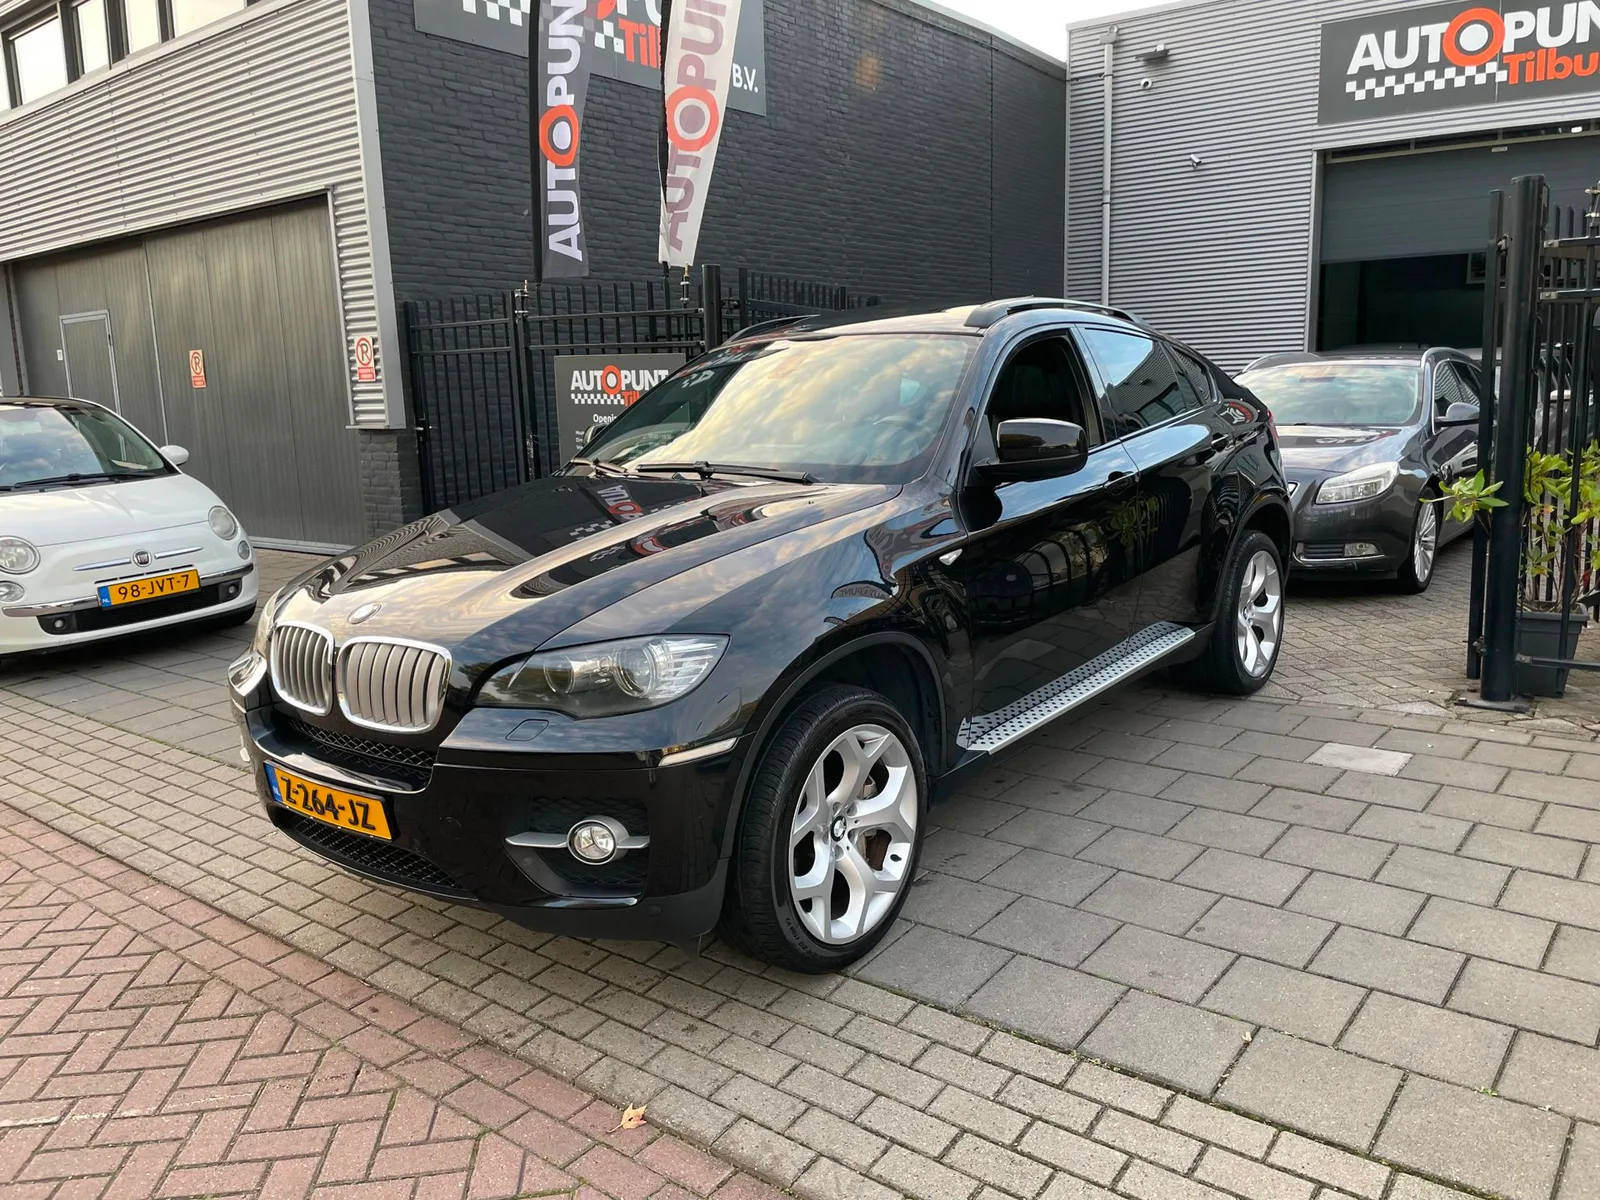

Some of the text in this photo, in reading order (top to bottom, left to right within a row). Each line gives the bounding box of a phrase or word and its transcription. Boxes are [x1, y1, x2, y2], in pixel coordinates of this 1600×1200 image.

[732, 62, 759, 93] B.V.
[118, 574, 190, 600] 98-JVT-7
[280, 776, 376, 830] Z-264-JZ
